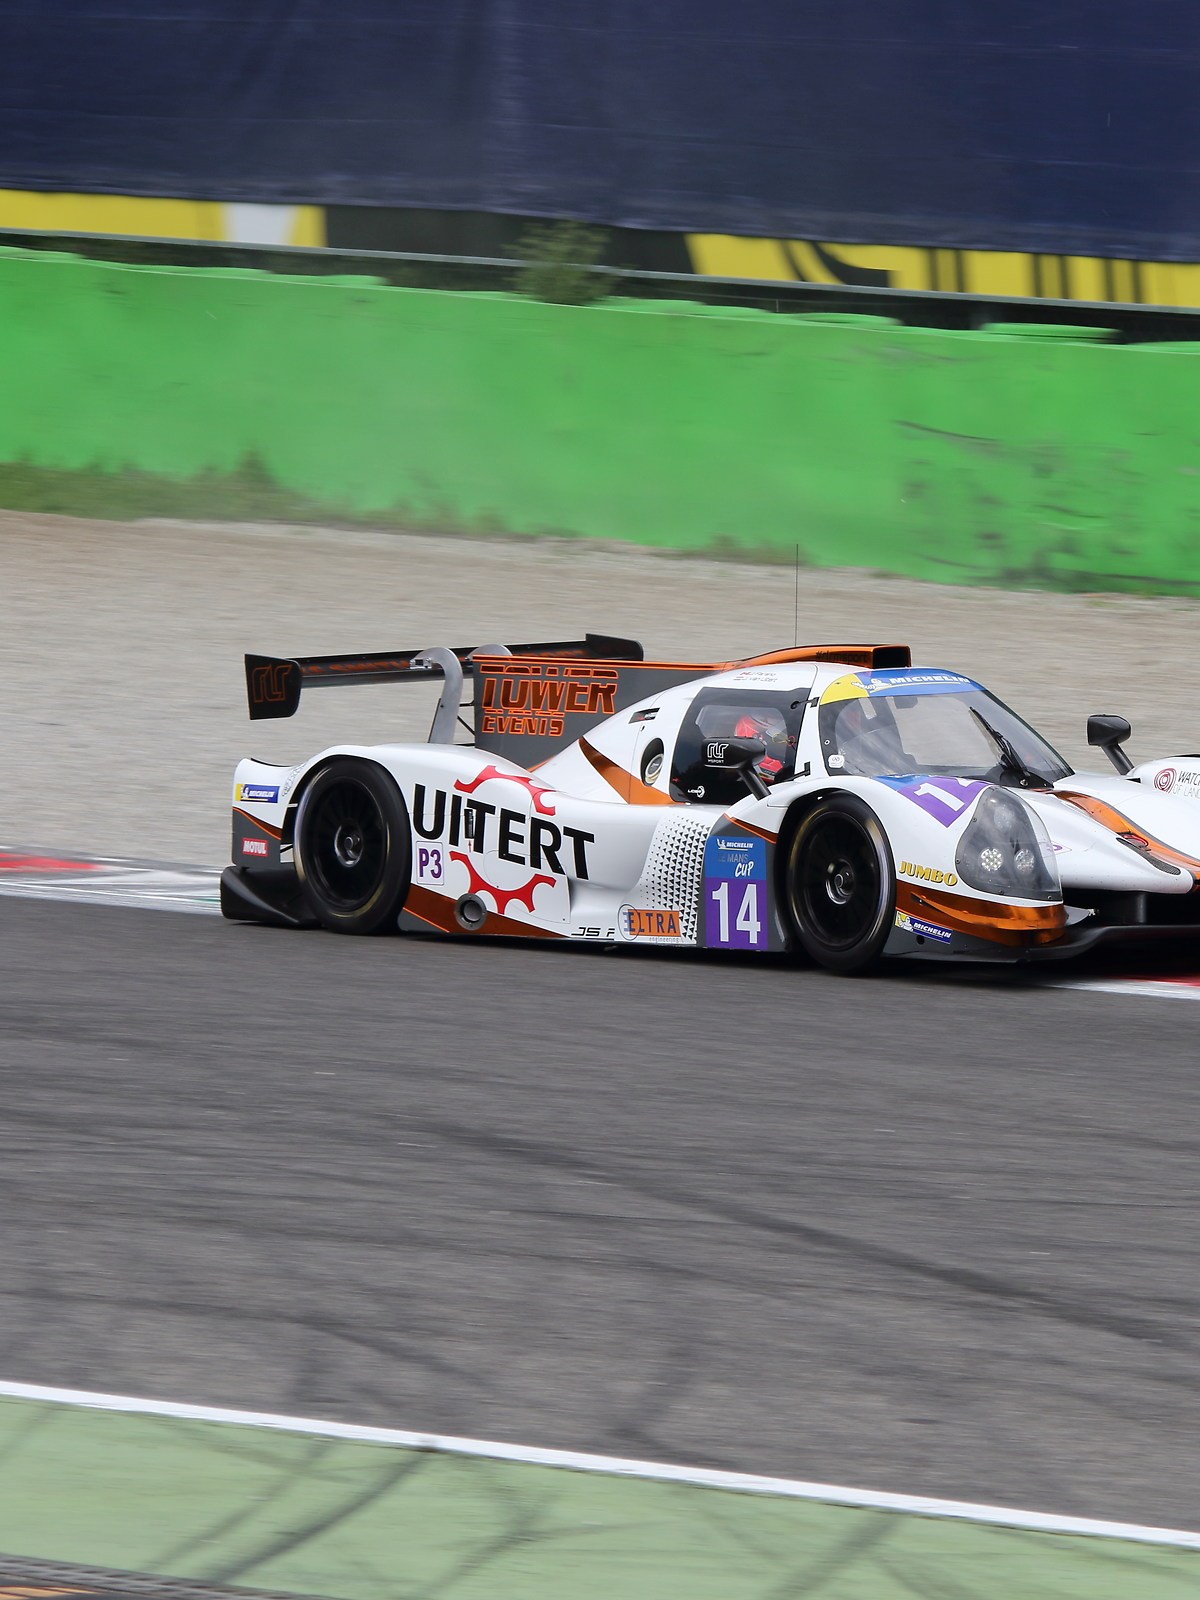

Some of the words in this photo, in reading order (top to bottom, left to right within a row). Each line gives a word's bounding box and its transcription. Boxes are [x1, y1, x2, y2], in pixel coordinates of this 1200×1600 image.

[480, 664, 618, 714] TOWER
[889, 675, 970, 684] MICHELIN
[481, 708, 565, 736] EVENTS
[412, 783, 595, 881] UITERT
[243, 840, 267, 855] MOTUL
[727, 853, 749, 864] MANS
[418, 848, 442, 879] P3
[735, 861, 754, 878] CUP
[899, 861, 957, 887] JUMBO
[712, 882, 761, 944] 14
[913, 922, 952, 938] MICHELIN
